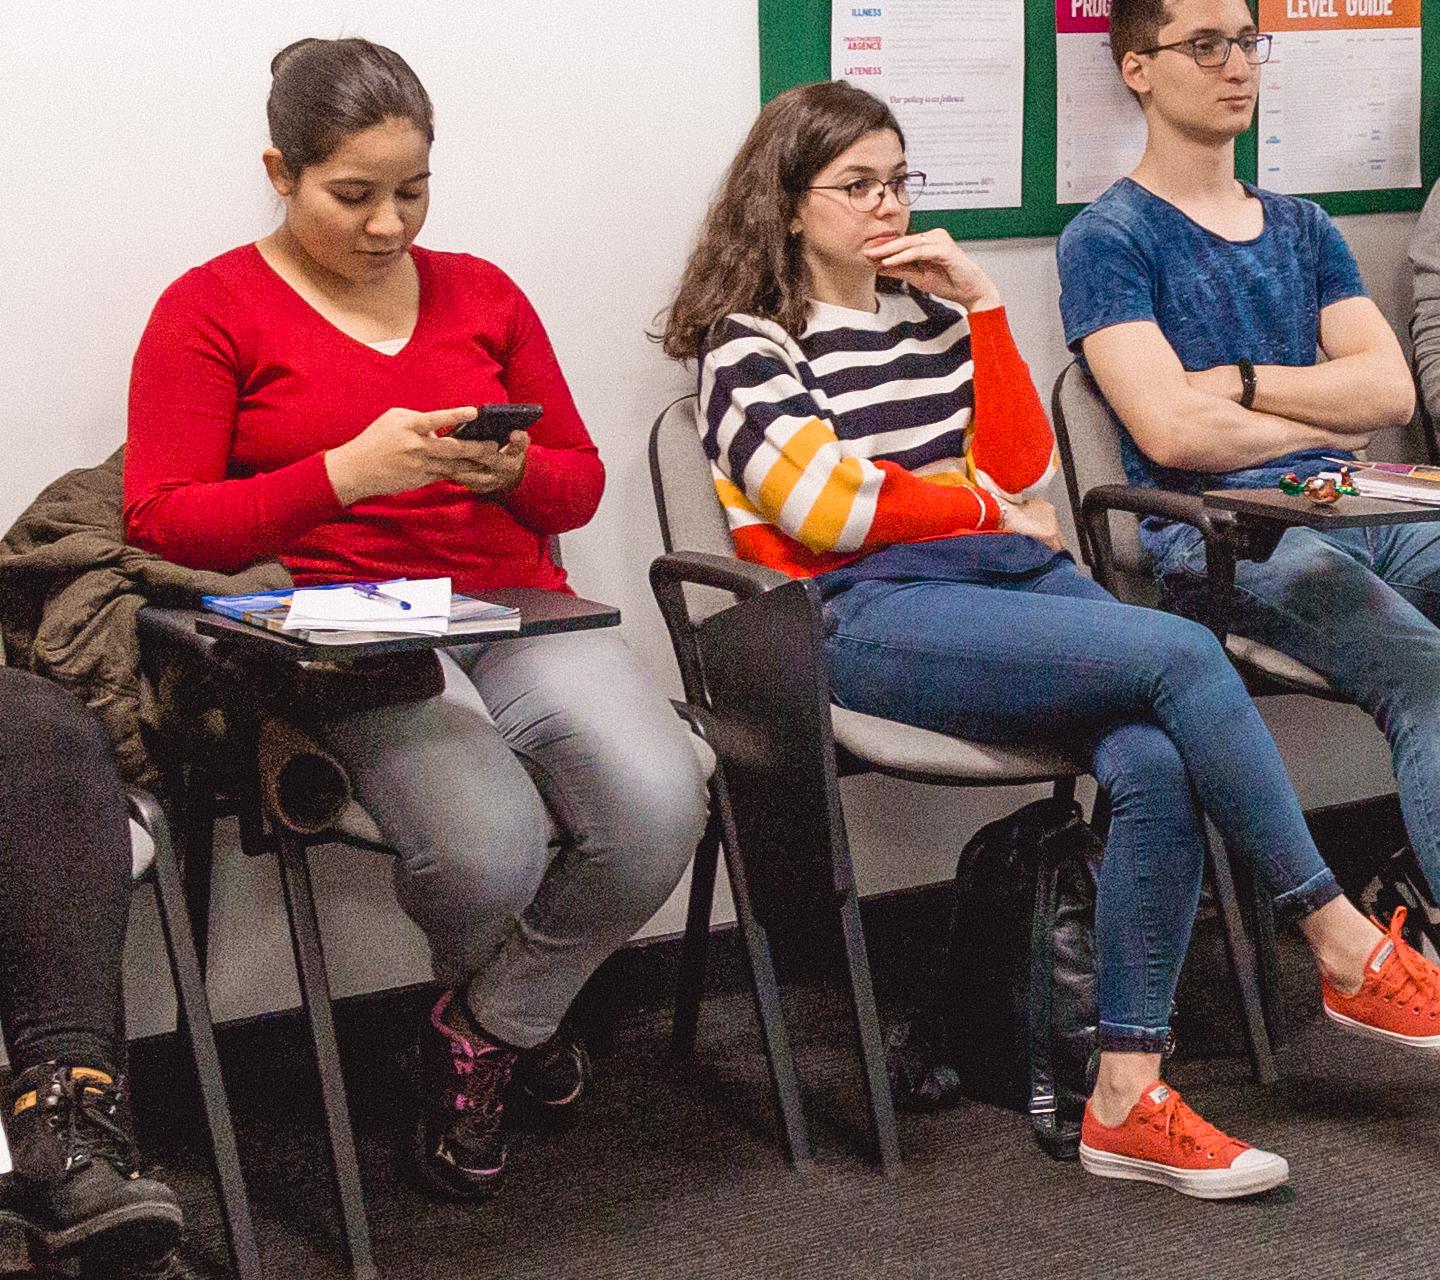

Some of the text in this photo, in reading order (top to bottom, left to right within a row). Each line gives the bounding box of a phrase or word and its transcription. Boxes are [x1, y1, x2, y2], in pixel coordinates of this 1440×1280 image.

[851, 9, 882, 17] ILLNESS
[847, 42, 882, 51] ABSENCE
[844, 67, 882, 76] LATENESS
